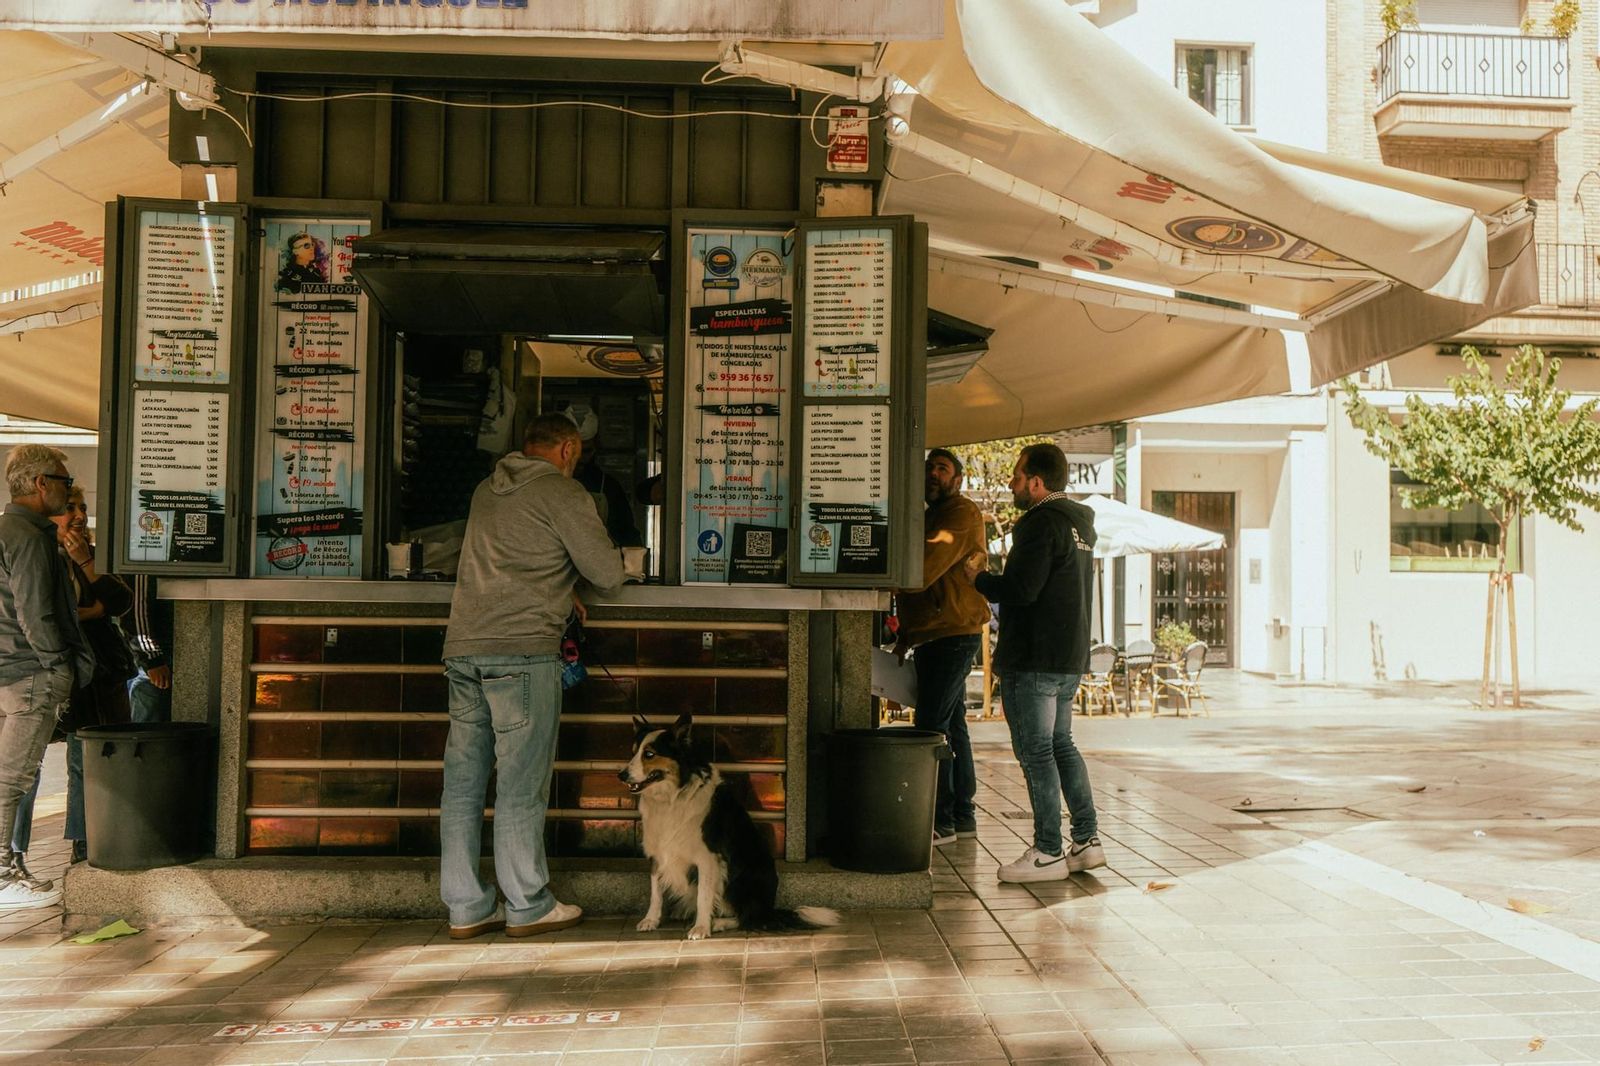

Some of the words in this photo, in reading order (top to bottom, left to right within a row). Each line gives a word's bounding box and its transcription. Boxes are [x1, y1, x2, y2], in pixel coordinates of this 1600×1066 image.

[332, 236, 345, 246] You
[743, 266, 787, 275] HERMANOS
[291, 302, 317, 310] RÉCORD
[715, 308, 767, 317] ESPECIALISTAS
[709, 316, 784, 331] hamburguesa
[165, 330, 205, 339] Ingredientes
[830, 345, 866, 355] Ingredientes
[720, 373, 737, 381] 959
[751, 374, 762, 382] 76
[763, 374, 774, 382] 57
[719, 405, 752, 415] Horario
[317, 419, 328, 427] 1kg
[302, 479, 312, 487] 19
[277, 516, 302, 524] Supera
[303, 514, 315, 522] los
[315, 512, 345, 521] Récords
[282, 527, 288, 535] y
[273, 546, 303, 558] RECORD
